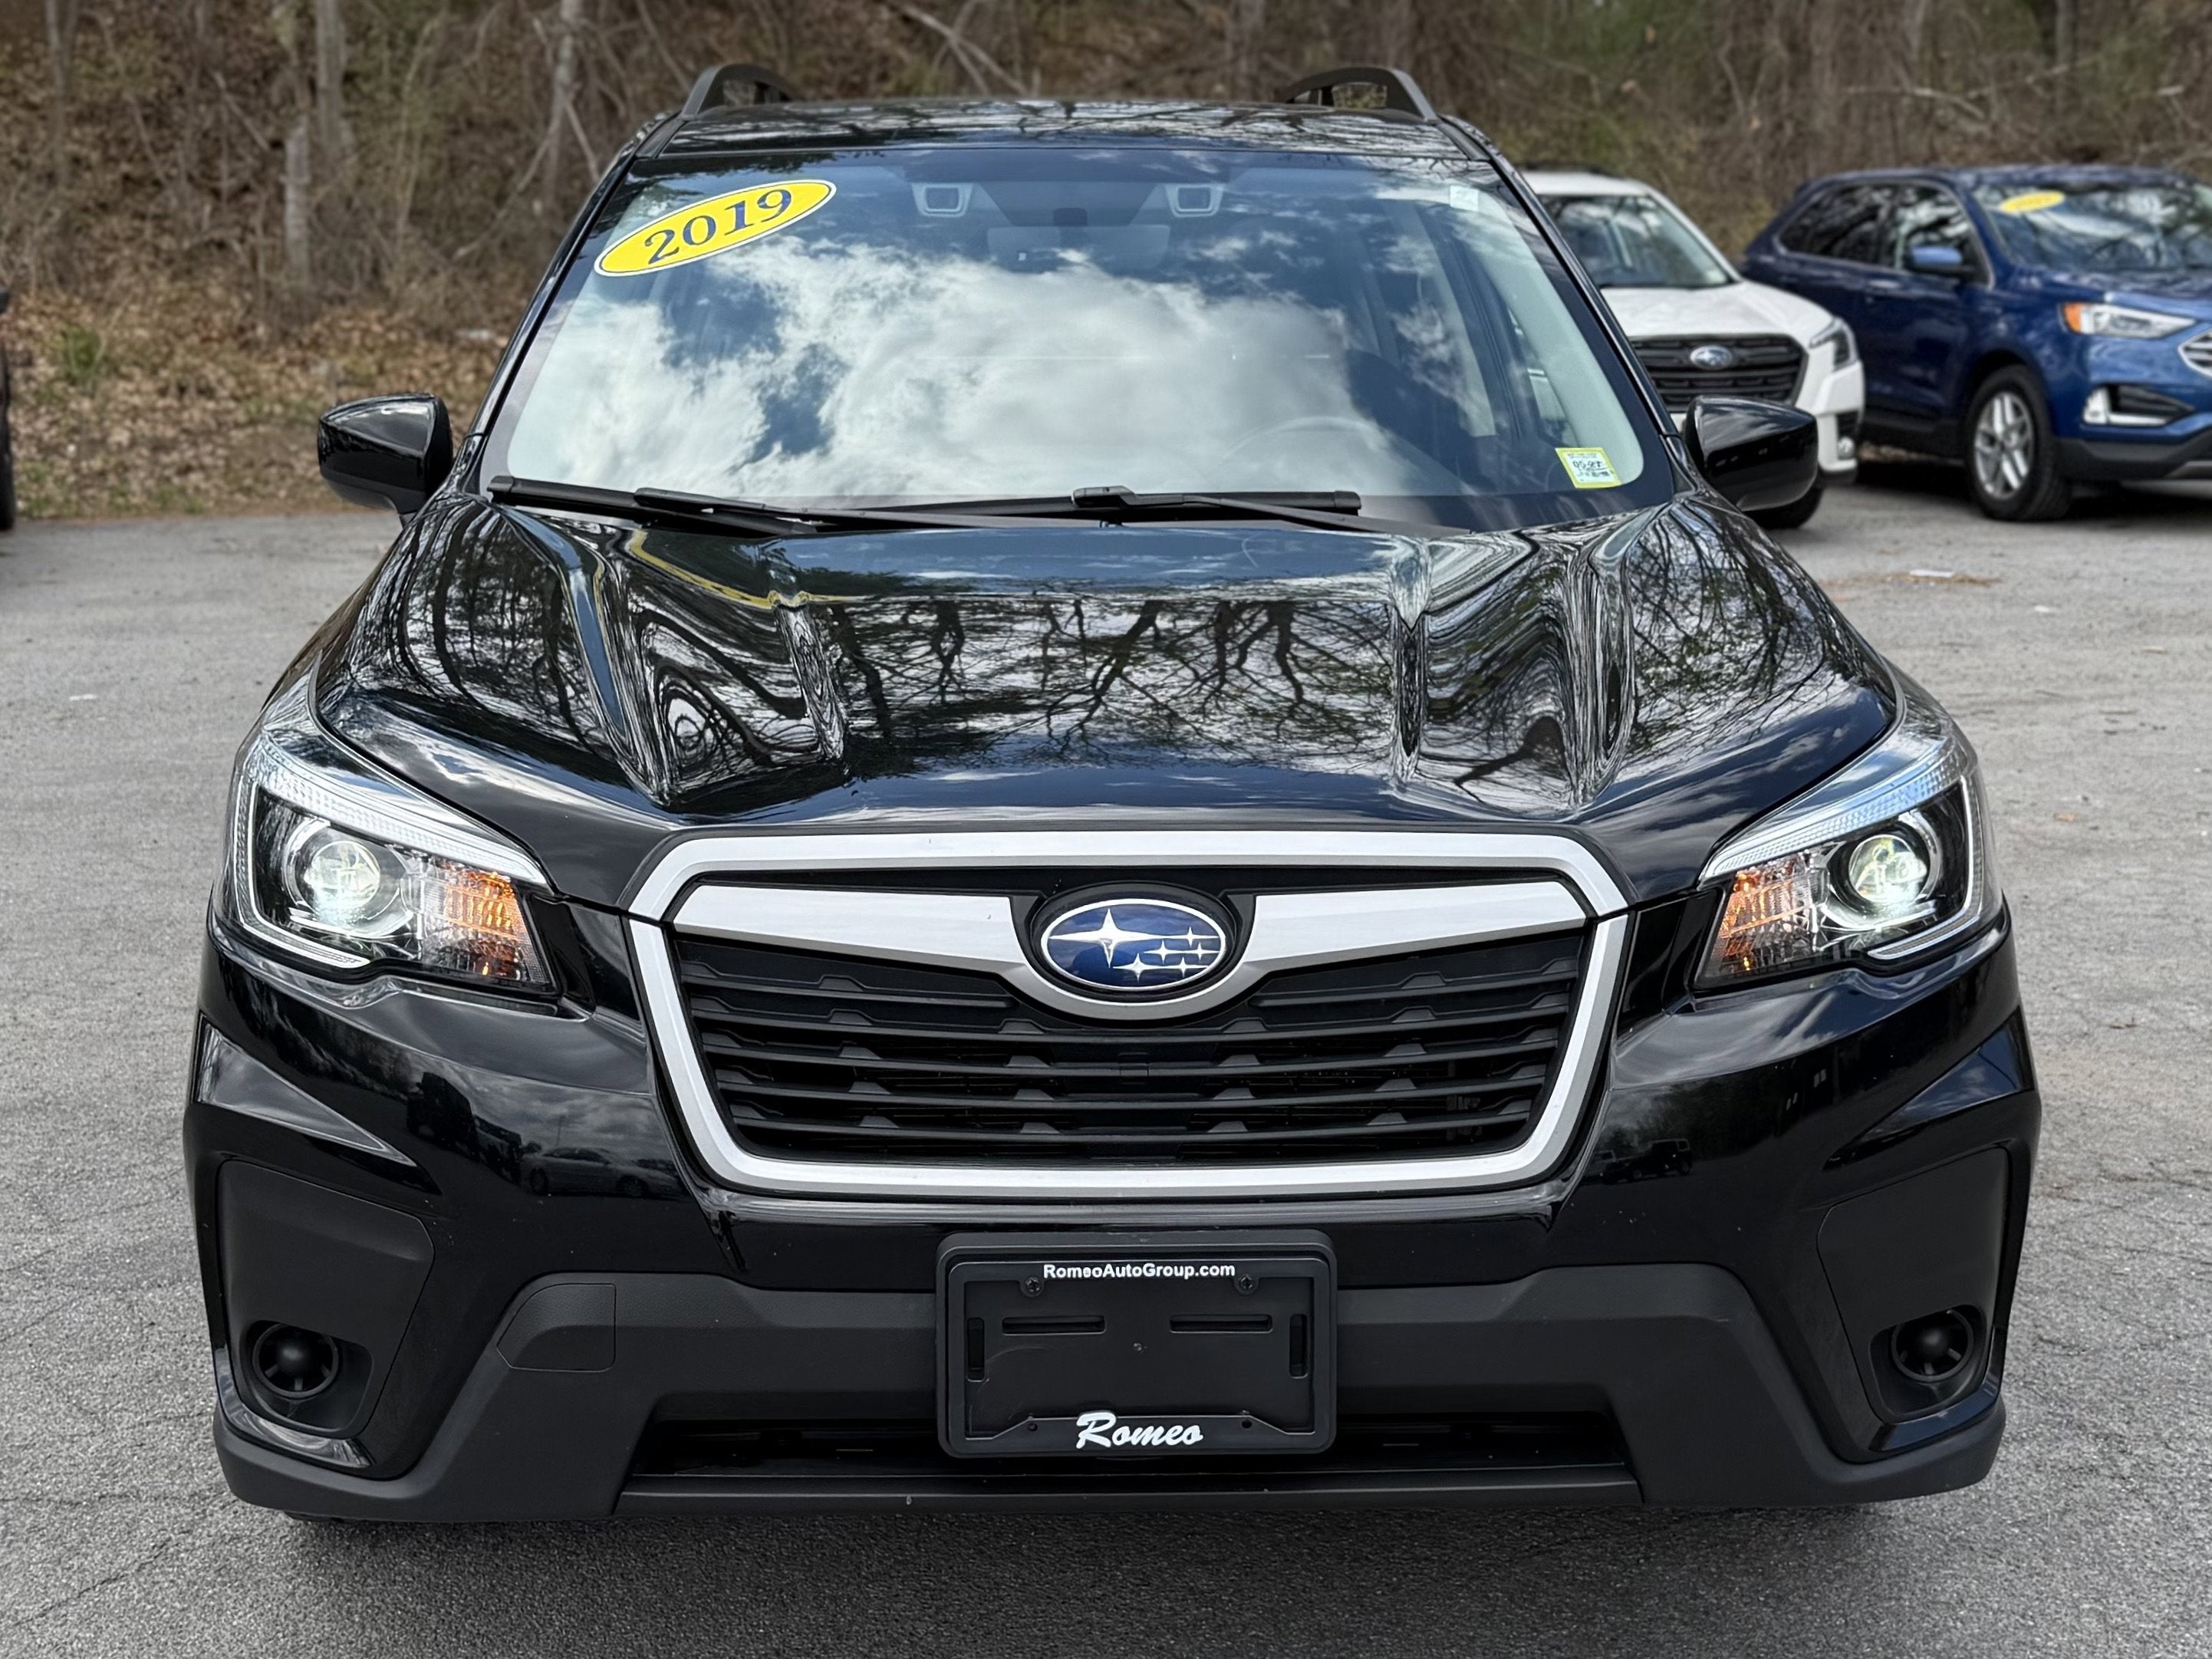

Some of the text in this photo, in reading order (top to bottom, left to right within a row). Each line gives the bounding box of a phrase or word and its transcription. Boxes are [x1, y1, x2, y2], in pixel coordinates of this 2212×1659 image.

[644, 189, 792, 265] 2019
[1043, 1262, 1236, 1280] RomeoAutoGroup.com
[1075, 1411, 1203, 1450] Romeo
